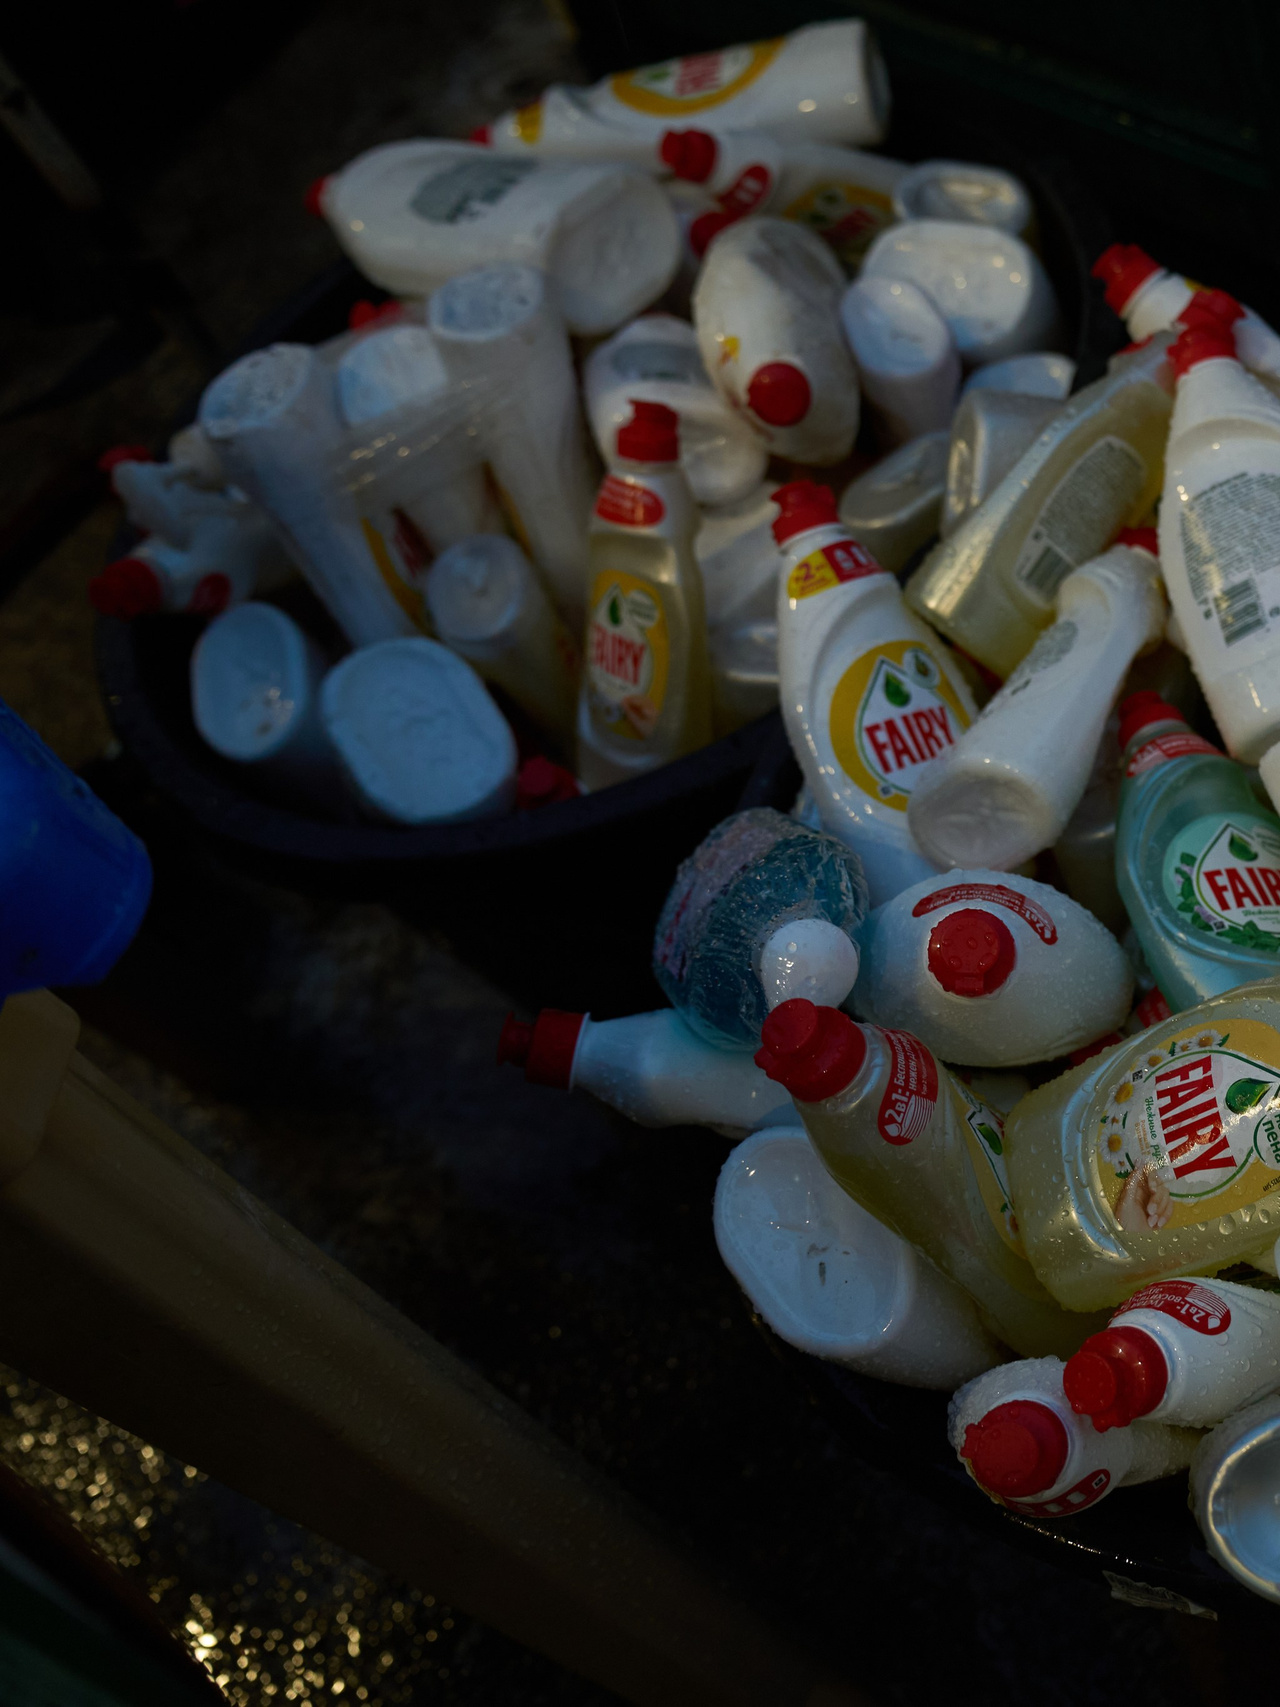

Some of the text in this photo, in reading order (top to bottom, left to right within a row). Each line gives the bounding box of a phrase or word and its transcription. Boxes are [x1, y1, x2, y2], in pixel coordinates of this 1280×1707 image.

[865, 706, 953, 773] FAIRY
[1145, 1096, 1157, 1140] Нежные
[1155, 1055, 1237, 1180] FAIRY
